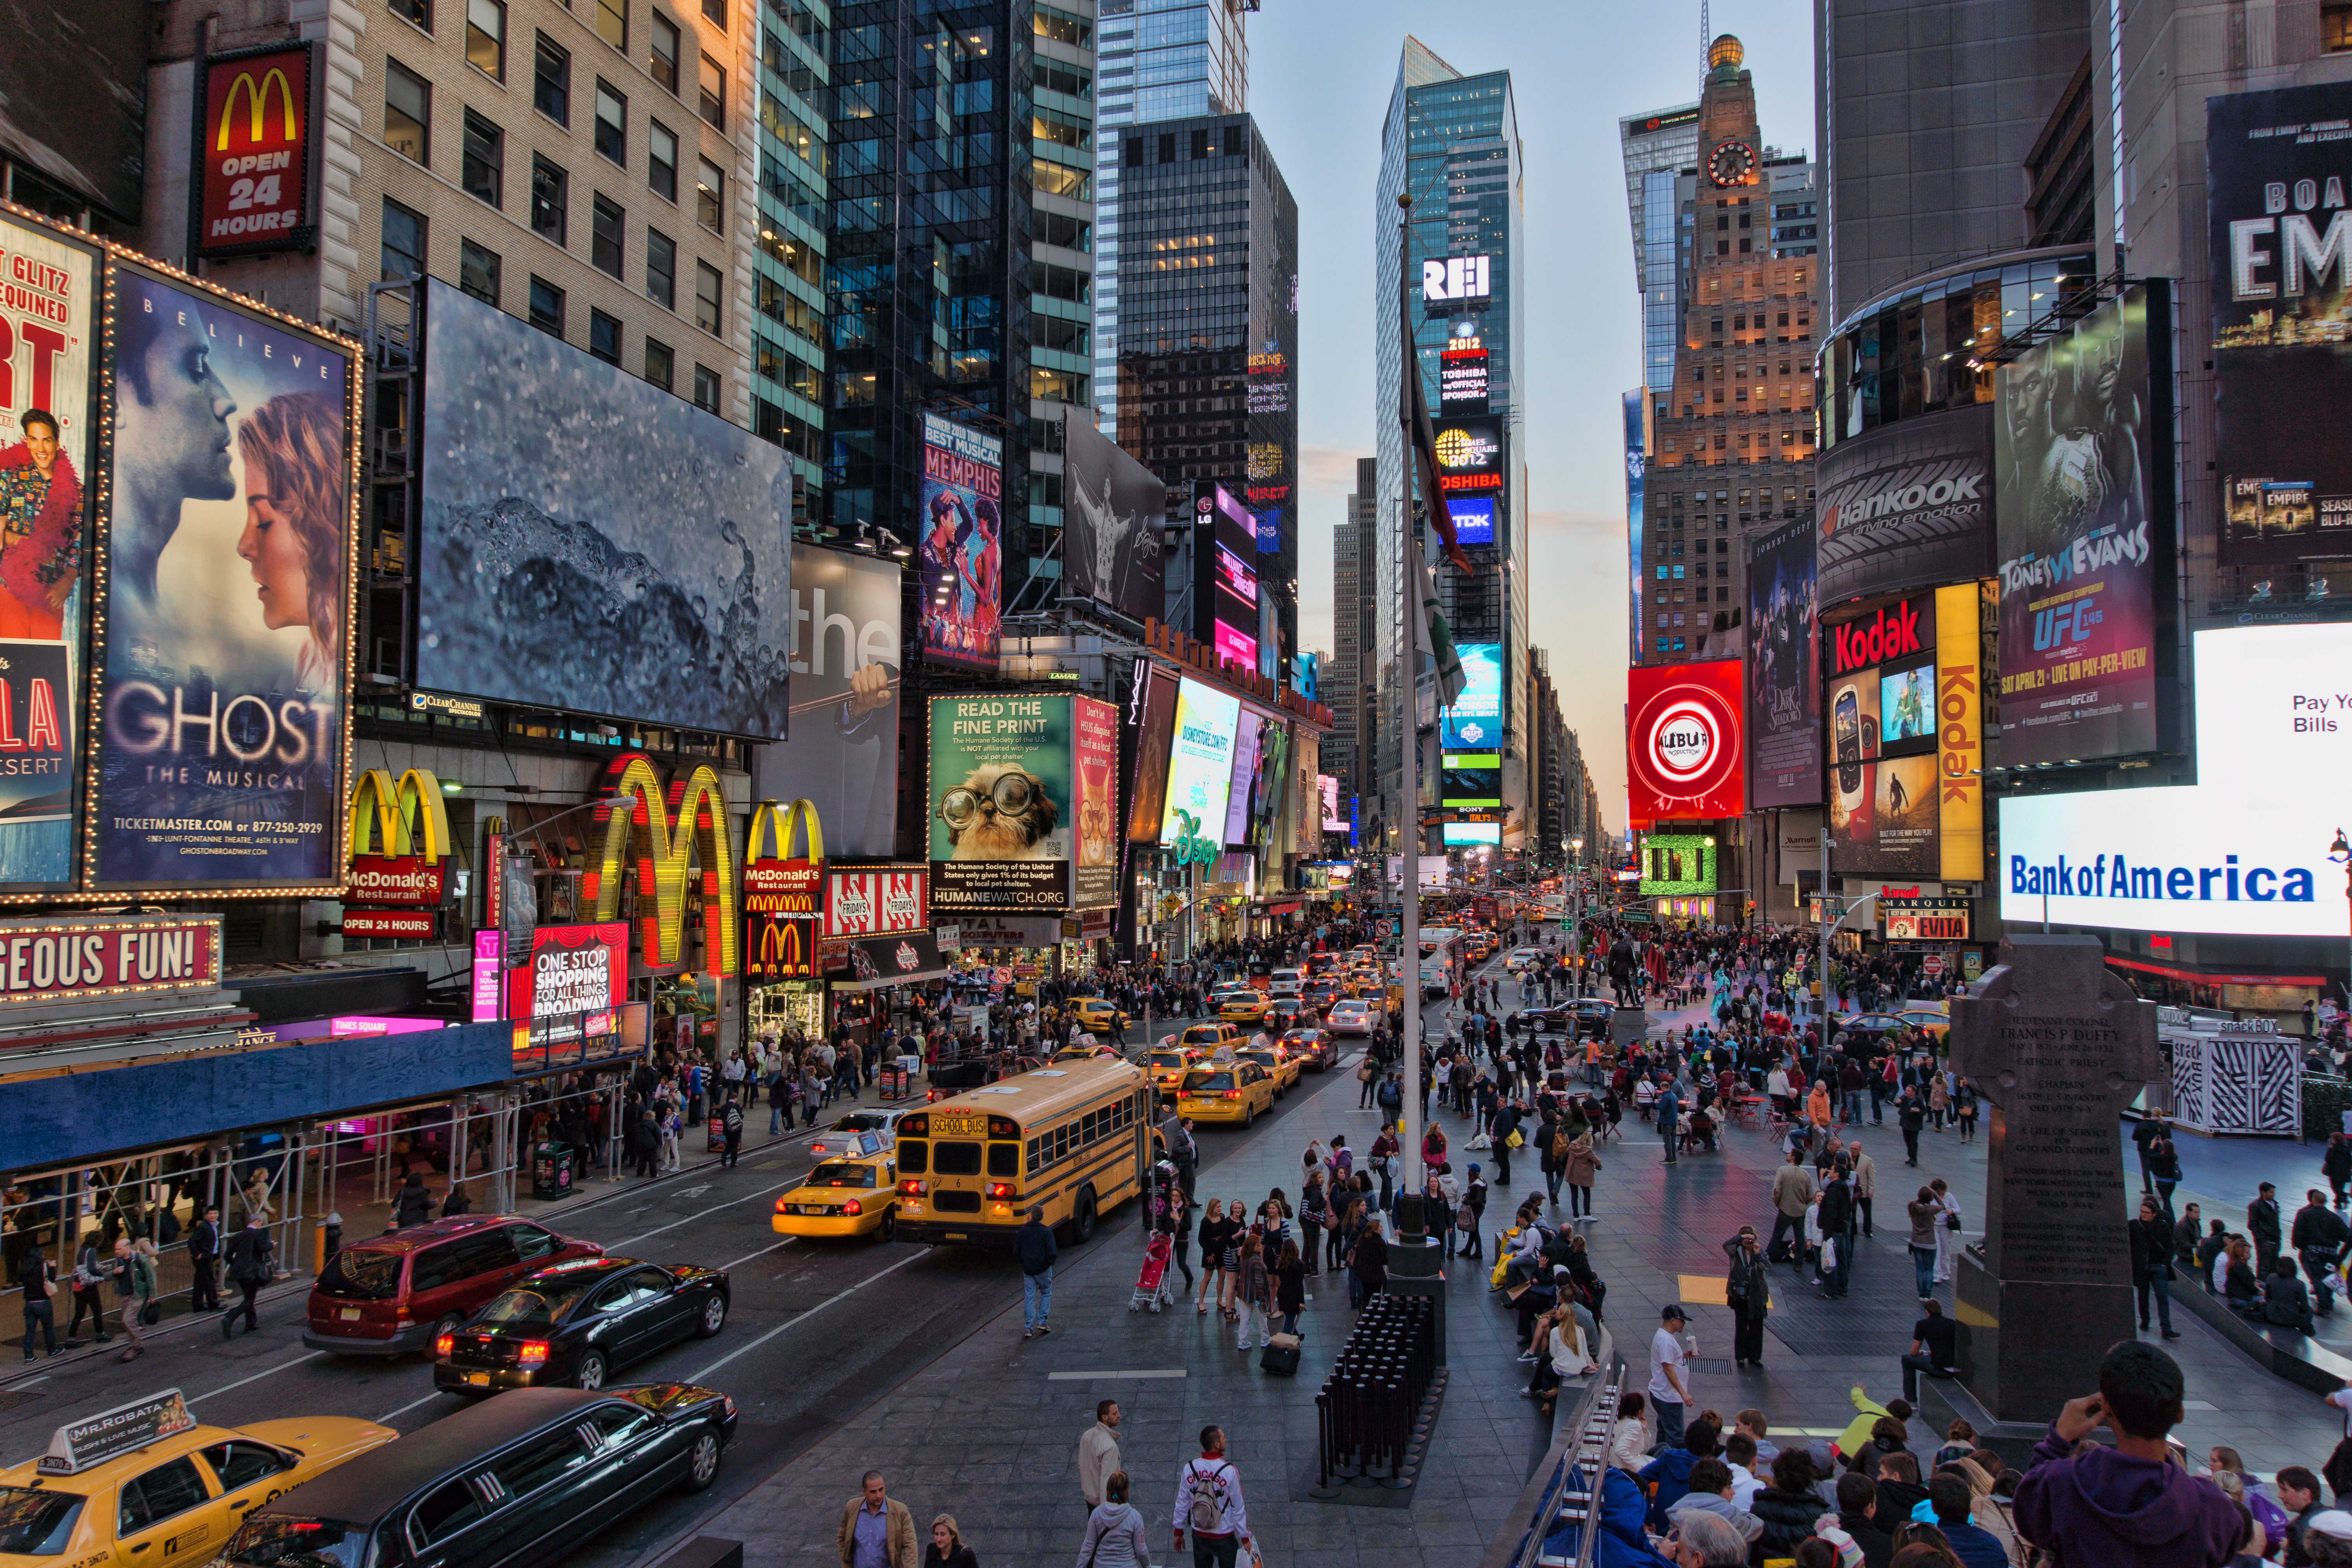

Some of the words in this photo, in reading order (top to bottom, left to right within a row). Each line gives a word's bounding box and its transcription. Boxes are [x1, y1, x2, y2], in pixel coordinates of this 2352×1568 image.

[1680, 113, 1698, 122] REUTERS
[2249, 128, 2274, 139] FROM
[2296, 131, 2315, 144] AND
[222, 151, 290, 176] OPEN
[228, 174, 281, 210] 24
[212, 210, 297, 236] HOURS
[13, 256, 69, 297] GLITZ
[1424, 256, 1489, 301] REI
[143, 298, 328, 379] BELIEVE
[1449, 338, 1480, 350] 2012
[1441, 348, 1488, 360] TOSHIBA
[1441, 368, 1487, 379] TOSHIBA
[1451, 379, 1487, 389] OFFICIAL
[1442, 390, 1479, 400] SPONSOR
[926, 413, 951, 434] WINNER!
[952, 423, 966, 439] 2010
[967, 429, 982, 446] TONY
[982, 436, 1002, 453] AWARD
[926, 426, 953, 448] BEST
[955, 438, 1001, 466] MUSICAL
[1459, 438, 1485, 447] TIMES
[1464, 445, 1497, 454] SQUARE
[925, 446, 1000, 497] MEMPHIS
[1441, 473, 1502, 489] OSHIBA
[960, 485, 976, 496] MUSICAL
[2267, 492, 2309, 506] EMPIRE
[1198, 515, 1212, 524] LG
[1452, 514, 1490, 528] TDK
[1853, 515, 1899, 537] driving
[1902, 502, 1982, 524] emotion
[1756, 535, 1786, 557] JOHNNY
[1791, 521, 1811, 538] DEPP
[1223, 551, 1243, 576] BRILLIANCE
[1998, 553, 2051, 601] JONES
[2072, 521, 2149, 574] EVANS
[2033, 598, 2094, 652] UFC
[2083, 610, 2103, 627] 145
[790, 588, 901, 679] the
[1835, 600, 1920, 673] Kodak
[1234, 637, 1248, 653] MARQUEE
[2002, 674, 2015, 694] SAT
[2015, 671, 2037, 691] APRIL
[2037, 671, 2045, 688] 21
[2052, 663, 2068, 684] LIVE
[2069, 660, 2081, 681] ON
[2082, 646, 2147, 679] PAY-PER-VIEW
[1773, 686, 1797, 711] DARK
[2293, 695, 2330, 713] Pay
[448, 708, 481, 717] SPECTACOLOR
[958, 703, 1004, 717] READ
[1008, 701, 1042, 716] THE
[1770, 703, 1801, 731] SHADOWS
[107, 680, 335, 765] GHOST
[953, 720, 991, 735] FINE
[996, 719, 1047, 734] PRINT
[2294, 717, 2337, 732] Bills
[1183, 726, 1228, 751] DISNEYSTORE.COM/FFC
[1940, 664, 1977, 804] Kodak
[146, 765, 189, 785] THE
[207, 769, 305, 791] MUSICAL
[1778, 773, 1788, 784] MAY
[114, 817, 233, 832] TICKETMASTER.COM
[236, 822, 249, 832] or
[252, 820, 323, 834] 877-250-2929
[1469, 813, 1491, 822] ITALY'S
[164, 834, 223, 844] LUNT-FONTANNE
[224, 835, 254, 845] THEATRE,
[254, 836, 272, 845] 46TH
[280, 837, 299, 845] B'WAY
[179, 846, 268, 856] GHOSTONBROADWAY.COM
[347, 871, 438, 888] McDonald's
[745, 869, 820, 881] McDonald's
[2011, 854, 2073, 895] Bank
[2078, 853, 2105, 897] of
[2111, 855, 2315, 902] America
[356, 889, 421, 900] Restaurant
[935, 891, 1064, 903] HUMANEWATCH.ORG
[1075, 890, 1113, 903] HUMANEWATCH.ORG
[343, 919, 374, 929] OPEN
[376, 920, 390, 929] 24
[392, 920, 429, 931] HOURS
[1920, 917, 1964, 938] EVITA
[960, 931, 1024, 939] COMPUTERS
[0, 935, 104, 991] EOUS
[119, 930, 194, 982] FUN!
[537, 952, 569, 972] ONE
[572, 949, 607, 969] STOP
[535, 966, 608, 989] SHOPPING
[536, 988, 555, 1002] FOR
[556, 986, 574, 1000] ALL
[575, 982, 607, 998] THINGS
[534, 993, 608, 1020] BROADWAY
[2158, 1007, 2169, 1021] HOT
[335, 1020, 357, 1031] TIMES
[358, 1022, 387, 1032] SQUARE
[2001, 1027, 2057, 1040] FRANCIS
[2073, 1029, 2120, 1042] DUFFY
[2016, 1058, 2063, 1067] CATHOLIC
[2070, 1058, 2105, 1067] PRIEST
[2038, 1080, 2084, 1089] CHAPLAIN
[934, 1119, 965, 1132] SCHOOL
[967, 1120, 984, 1133] BUS
[74, 1441, 100, 1454] SUSHI
[107, 1431, 126, 1442] LIVE
[128, 1421, 152, 1434] MUSIC
[46, 1458, 64, 1468] 3N70
[1187, 1470, 1227, 1488] CHICAGO
[87, 1550, 109, 1567] 3N70
